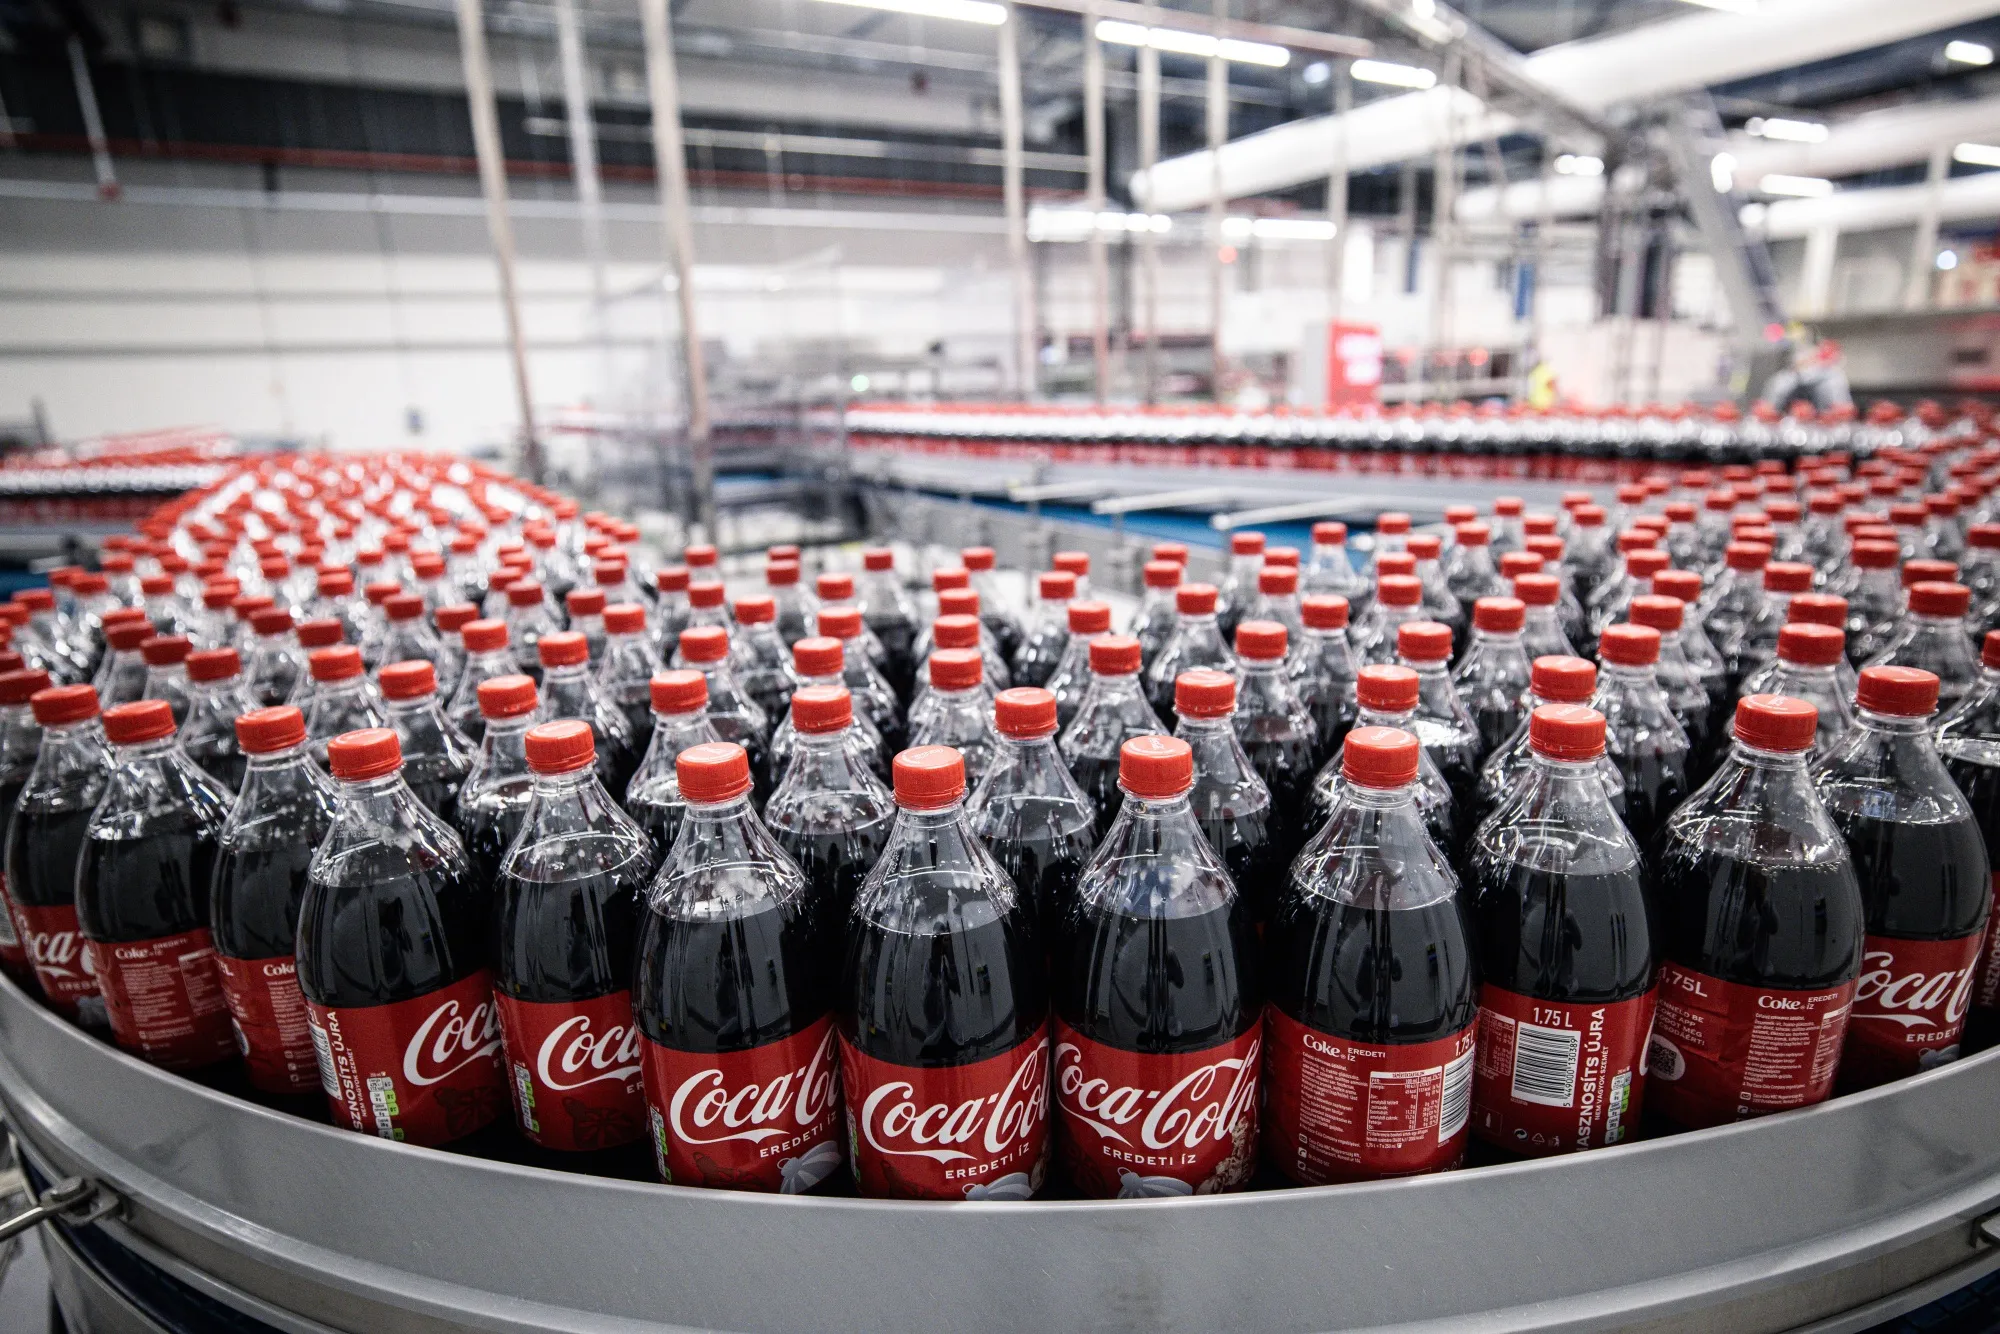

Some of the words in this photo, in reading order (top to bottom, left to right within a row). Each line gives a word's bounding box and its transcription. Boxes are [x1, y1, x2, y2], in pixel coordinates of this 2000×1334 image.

[1758, 995, 1801, 1010] Coke
[1808, 993, 1838, 1003] EREDETI
[1533, 1007, 1561, 1026] 1,75
[1565, 1012, 1573, 1028] L
[1679, 1017, 1696, 1026] APP
[1692, 1014, 1704, 1023] BE
[327, 1011, 345, 1052] ÚJRA
[1584, 1008, 1605, 1052] ÚJRA
[1303, 1034, 1341, 1058] Coke
[1347, 1047, 1386, 1059] EREDETI
[1568, 1038, 1578, 1066] 130389
[1347, 1054, 1356, 1062] ÍZ
[1054, 1032, 1262, 1149] Coca-Cola
[1565, 1069, 1575, 1098] 449000
[759, 1124, 823, 1158] EREDETI
[945, 1153, 1013, 1180] EREDETI
[1018, 1142, 1029, 1156] ÍZ
[1103, 1145, 1173, 1166] EREDETI
[1181, 1154, 1196, 1165] ÍZ
